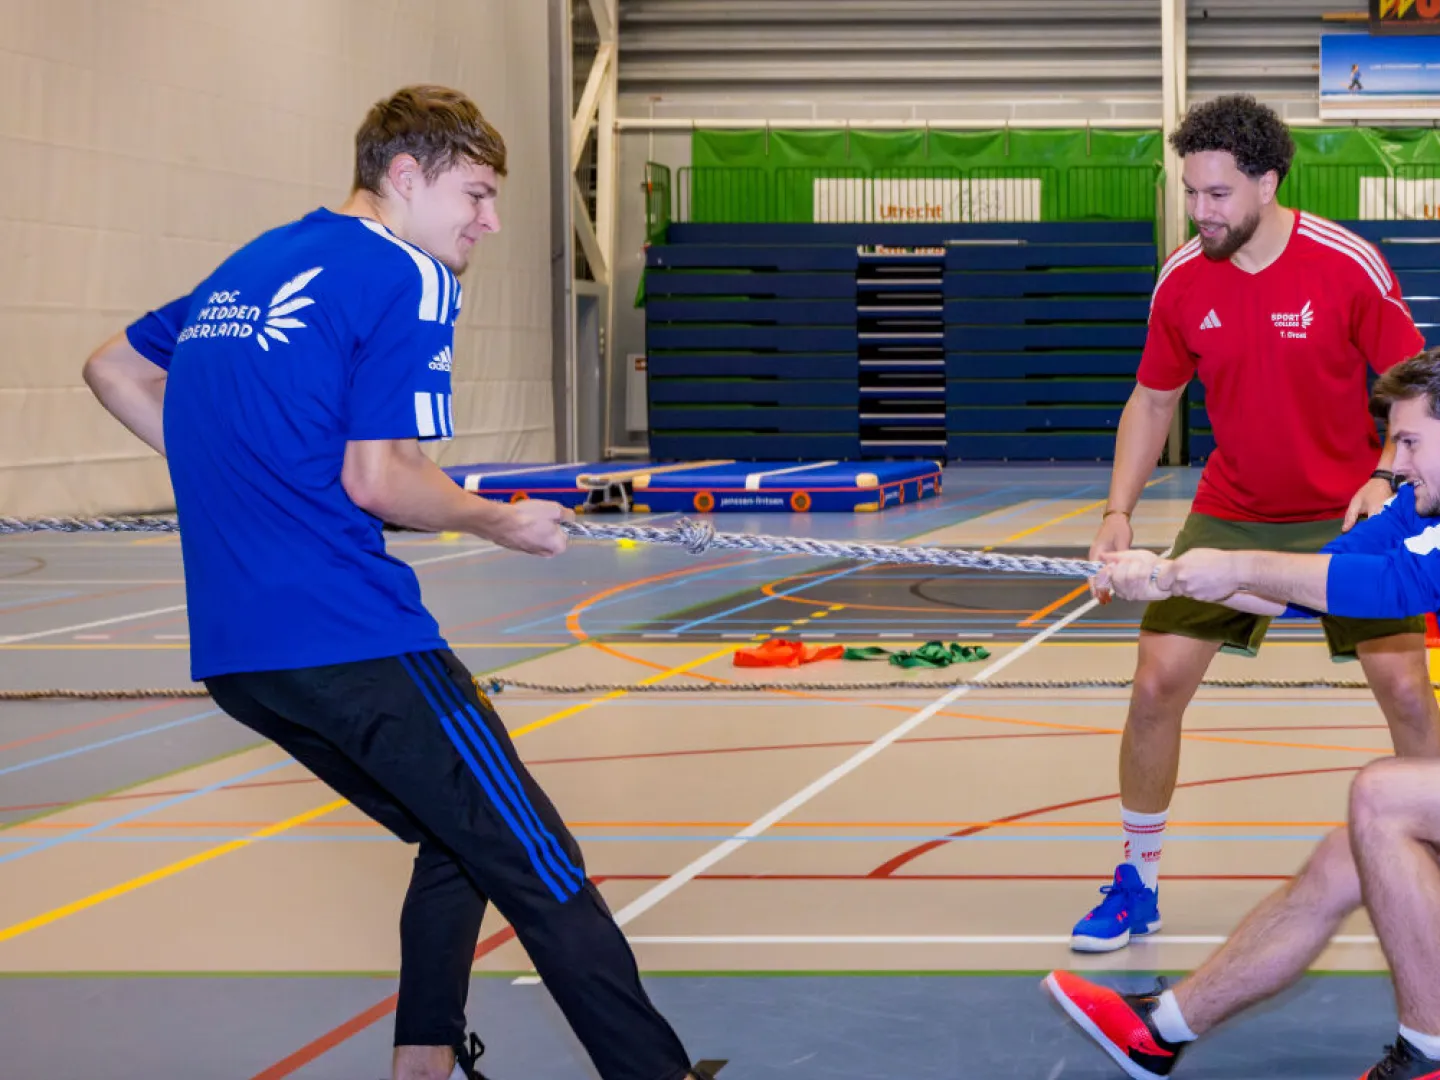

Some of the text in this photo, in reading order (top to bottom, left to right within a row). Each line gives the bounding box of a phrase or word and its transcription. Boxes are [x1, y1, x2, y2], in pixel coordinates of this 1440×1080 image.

[880, 202, 944, 220] Utrecht
[208, 289, 241, 304] ROC
[197, 304, 261, 322] MIDDEN
[1271, 312, 1300, 322] SPORT
